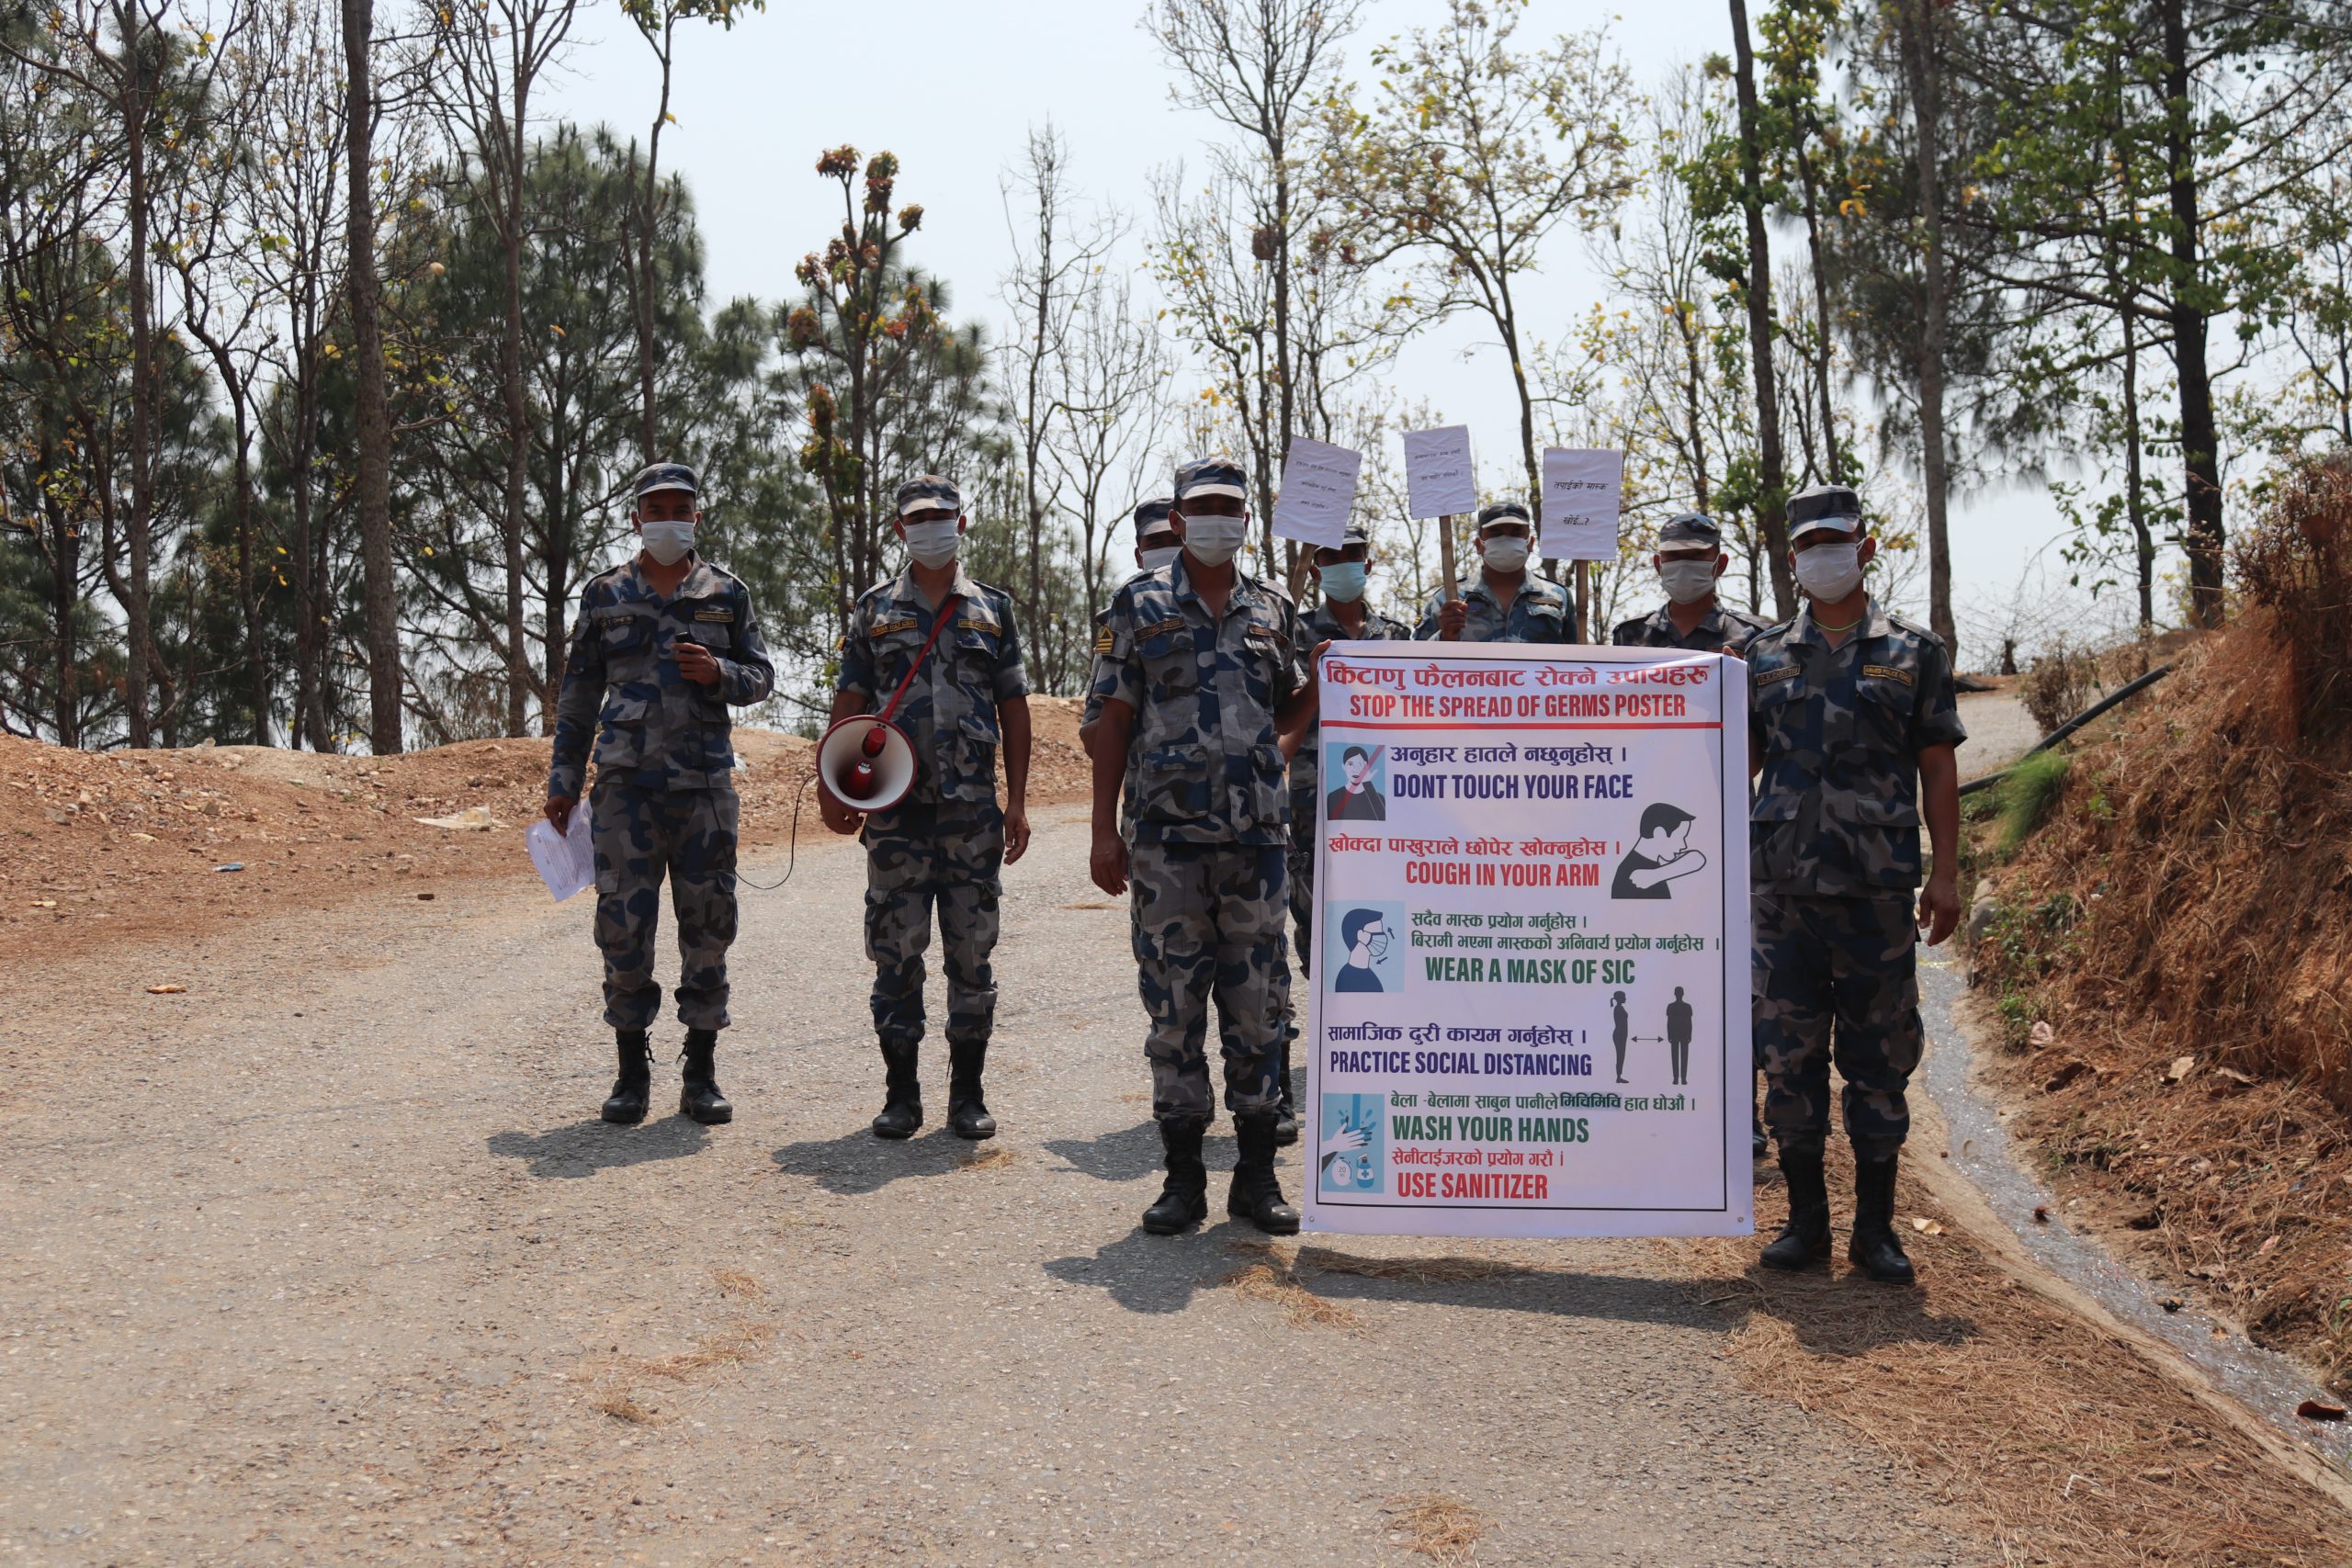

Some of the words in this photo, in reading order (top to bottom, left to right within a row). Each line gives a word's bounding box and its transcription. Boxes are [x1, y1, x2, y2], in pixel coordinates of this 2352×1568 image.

[1587, 482, 1609, 491] मास्क
[1412, 662, 1527, 689] फैलनबाट
[1534, 665, 1599, 687] रोक्ने
[1350, 694, 1396, 718] STOP
[1399, 694, 1435, 717] THE
[1439, 695, 1513, 718] SPREAD
[1517, 694, 1541, 717] OF
[1544, 694, 1611, 717] GERMS
[1614, 694, 1686, 717] POSTER
[1389, 746, 1459, 767] अनुहार
[1463, 741, 1519, 764] हातले
[1393, 773, 1448, 799] DONT
[1451, 773, 1520, 800] TOUCH
[1523, 773, 1579, 800] YOUR
[1584, 773, 1634, 799] FACE
[1328, 832, 1383, 853] खोक्दा
[1387, 836, 1460, 858] पाखुराले
[1464, 836, 1515, 857] छोपेर
[1518, 836, 1608, 860] खोक्नुहोस
[1406, 860, 1471, 886] COUGH
[1476, 863, 1496, 886] IN
[1499, 863, 1552, 887] YOUR
[1555, 863, 1600, 887] ARM
[1410, 908, 1443, 927] सदैव
[1445, 913, 1484, 929] मास्क
[1487, 911, 1524, 930] प्रयोग
[1528, 911, 1577, 931] गर्नुहोस
[1410, 930, 1454, 949] बिरामी
[1457, 934, 1494, 949] भएमा
[1497, 932, 1554, 951] मास्कको
[1556, 932, 1611, 951] अनिवार्य
[1613, 932, 1652, 953] प्रयोग
[1655, 933, 1705, 954] गर्नुहोस
[1424, 956, 1484, 983] WEAR
[1487, 958, 1503, 983] A
[1507, 958, 1567, 985] MASK
[1571, 958, 1598, 985] OF
[1601, 958, 1636, 985] SIC
[1327, 1021, 1404, 1042] सामाजिक
[1408, 1021, 1442, 1046] दुरी
[1446, 1027, 1503, 1043] कायम
[1507, 1024, 1575, 1048] गर्नुहोस्
[1330, 1050, 1411, 1074] PRACTICE
[1414, 1051, 1480, 1075] SOCIAL
[1484, 1052, 1592, 1077] DISTANCING
[1390, 1091, 1419, 1109] बेला
[1474, 1095, 1512, 1113] साबुन
[1514, 1091, 1560, 1111] पानीले
[1557, 1091, 1623, 1110] मिचिमिचि
[1623, 1097, 1650, 1112] हात
[1392, 1115, 1453, 1141] WASH
[1456, 1116, 1513, 1142] YOUR
[1518, 1117, 1589, 1144] HANDS
[1487, 1148, 1525, 1168] प्रयोग
[1397, 1171, 1437, 1198] USE
[1441, 1172, 1548, 1200] SANITIZER
